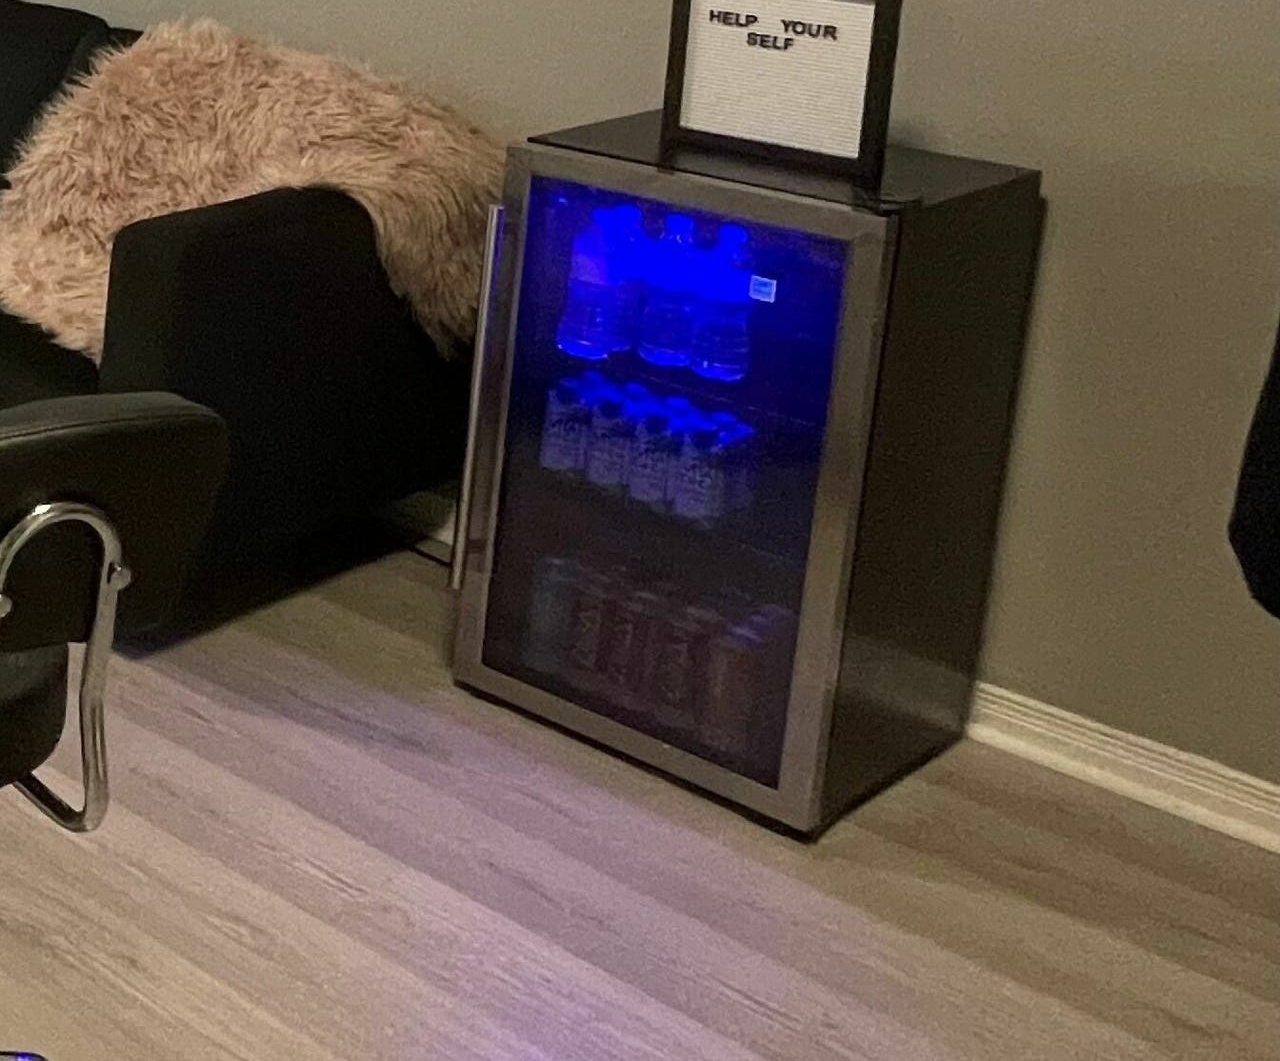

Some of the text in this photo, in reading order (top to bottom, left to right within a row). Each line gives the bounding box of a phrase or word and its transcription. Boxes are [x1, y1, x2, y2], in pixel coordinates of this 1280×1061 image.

[708, 9, 838, 40] HELP YOUR
[746, 32, 795, 50] SELF
